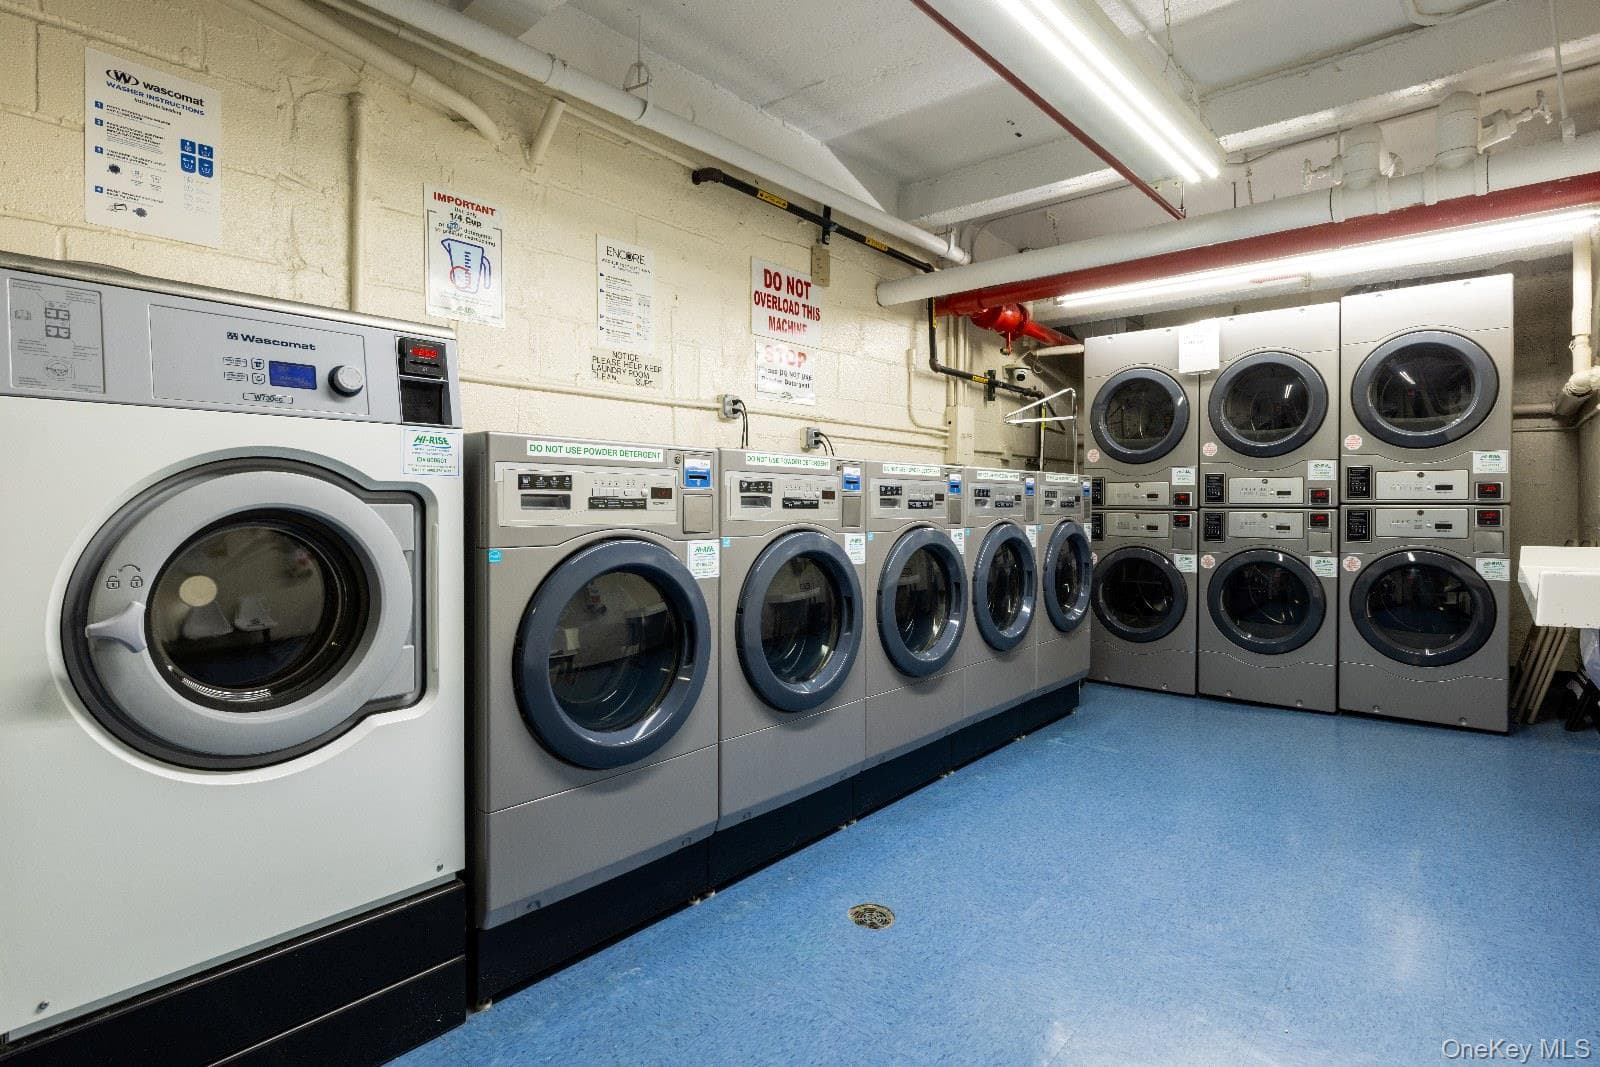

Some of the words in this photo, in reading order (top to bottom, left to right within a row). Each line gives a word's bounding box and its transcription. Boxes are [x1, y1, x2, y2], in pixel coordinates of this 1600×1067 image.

[106, 80, 145, 98] WASHER
[146, 93, 205, 116] INSTRUCTIONS
[142, 81, 205, 107] wascomat
[433, 191, 496, 216] IMPORTANT
[465, 216, 482, 228] Cup
[606, 244, 646, 266] ENCORE
[763, 268, 782, 292] DO
[786, 275, 812, 300] NOT
[753, 290, 800, 316] OVERLOAD
[801, 303, 821, 322] THIS
[768, 315, 808, 334] MACHINE
[240, 333, 316, 351] Wascomat
[592, 355, 621, 367] PLEASE
[623, 360, 643, 370] HELP
[644, 364, 663, 374] KEEP
[612, 350, 640, 362] NOTICE
[764, 344, 807, 368] STOP
[591, 363, 627, 375] LAUNDRY
[628, 369, 650, 380] ROOM
[414, 434, 450, 446] HI-RISE
[529, 444, 543, 453] DO
[545, 445, 563, 454] NOT
[565, 446, 582, 455] USE
[583, 447, 618, 457] POWDER
[619, 449, 662, 459] DETERGENT
